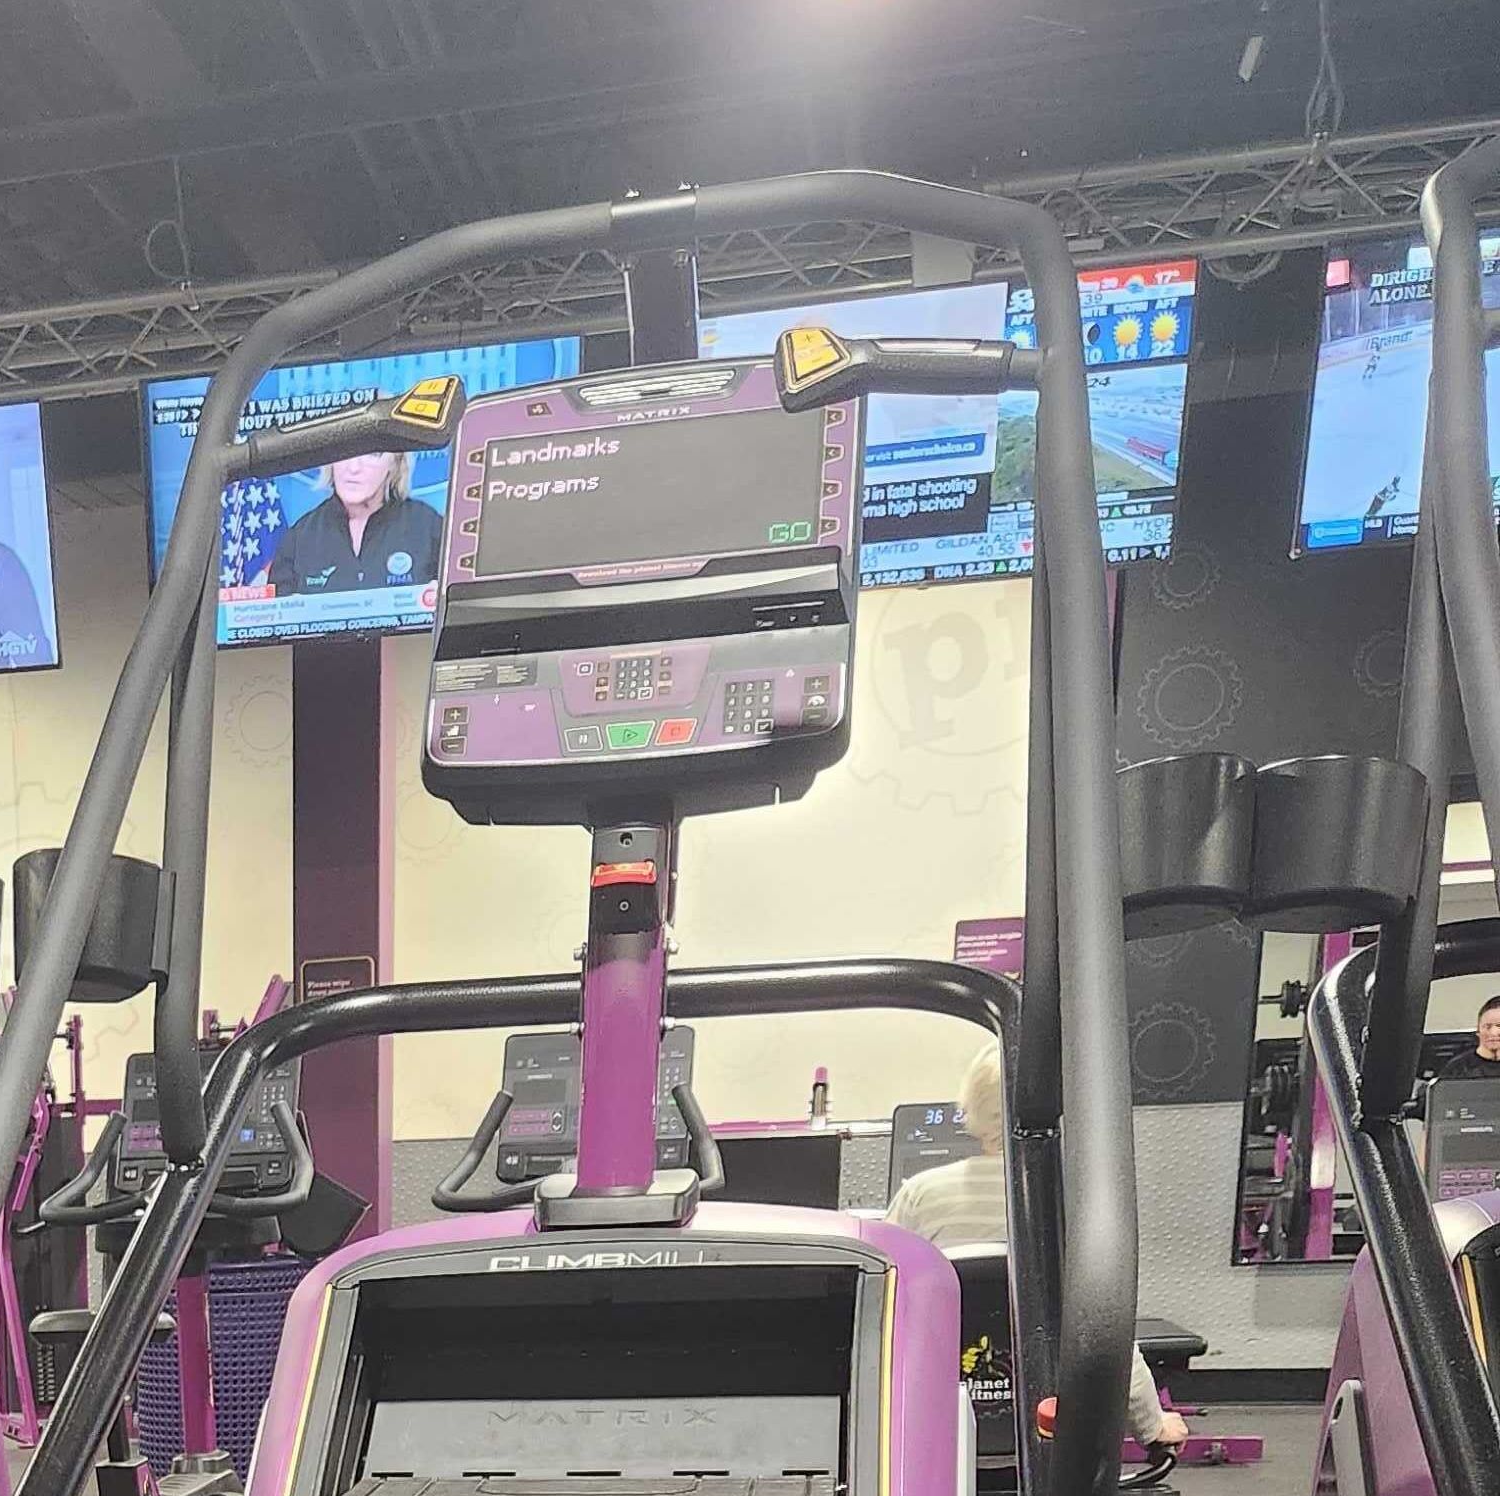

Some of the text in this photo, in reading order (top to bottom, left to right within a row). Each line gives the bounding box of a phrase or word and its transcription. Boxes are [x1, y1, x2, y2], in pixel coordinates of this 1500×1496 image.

[617, 405, 692, 422] MATRIX
[490, 437, 621, 467] Landmarks
[488, 473, 600, 501] Programs
[918, 477, 978, 496] shooting
[919, 493, 966, 512] school
[769, 521, 812, 544] GO
[924, 1108, 944, 1125] 36
[489, 1250, 704, 1271] CLIMBMILL
[487, 1408, 717, 1425] MATRIX
